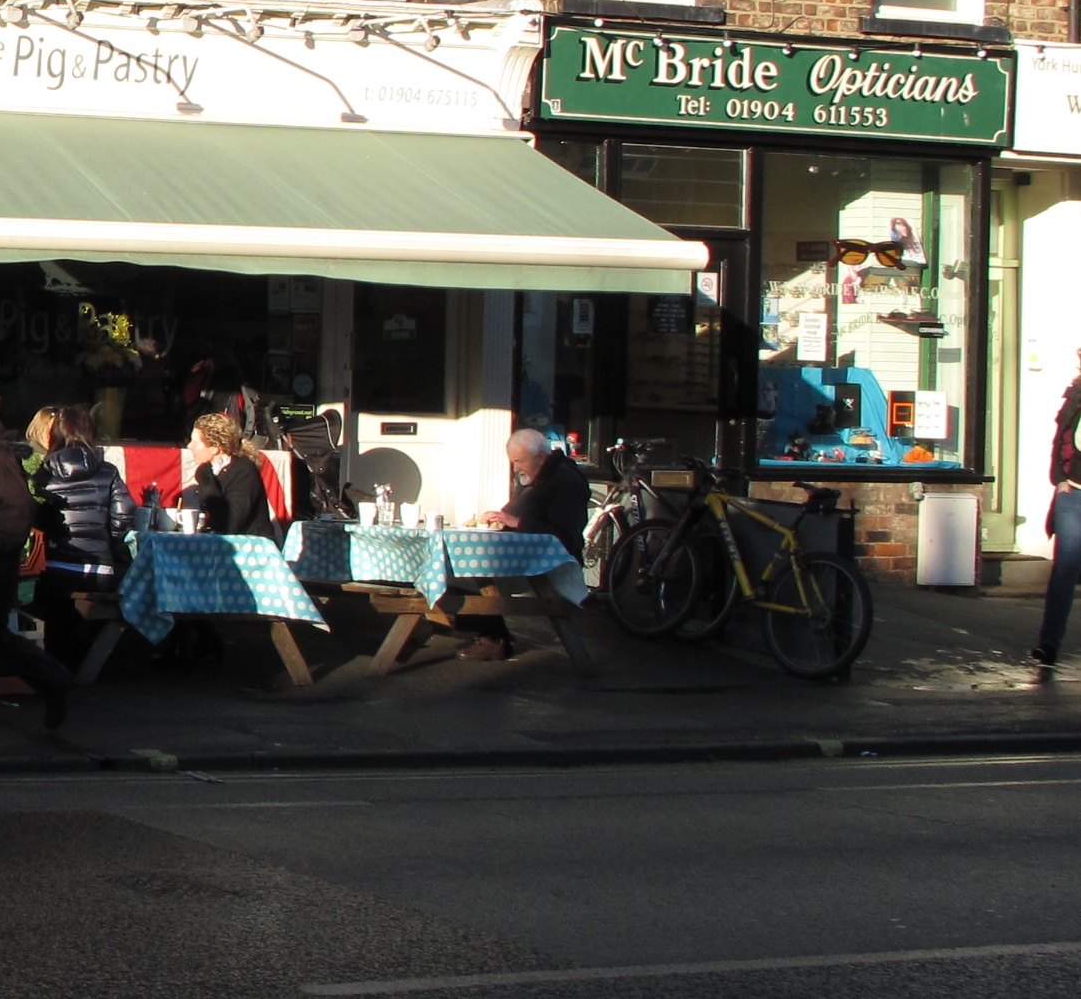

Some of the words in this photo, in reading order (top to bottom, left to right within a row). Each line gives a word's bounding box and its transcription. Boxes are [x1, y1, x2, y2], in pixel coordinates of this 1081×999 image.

[12, 35, 67, 91] Pig
[71, 54, 87, 79] &
[93, 39, 199, 96] Pastry
[1031, 56, 1058, 71] York
[810, 54, 979, 104] Opticians
[378, 86, 421, 103] 01904
[427, 89, 477, 107] 675115
[676, 95, 710, 116] Tel:
[726, 99, 795, 122] 01904
[813, 105, 888, 127] 611553
[54, 314, 70, 342] &
